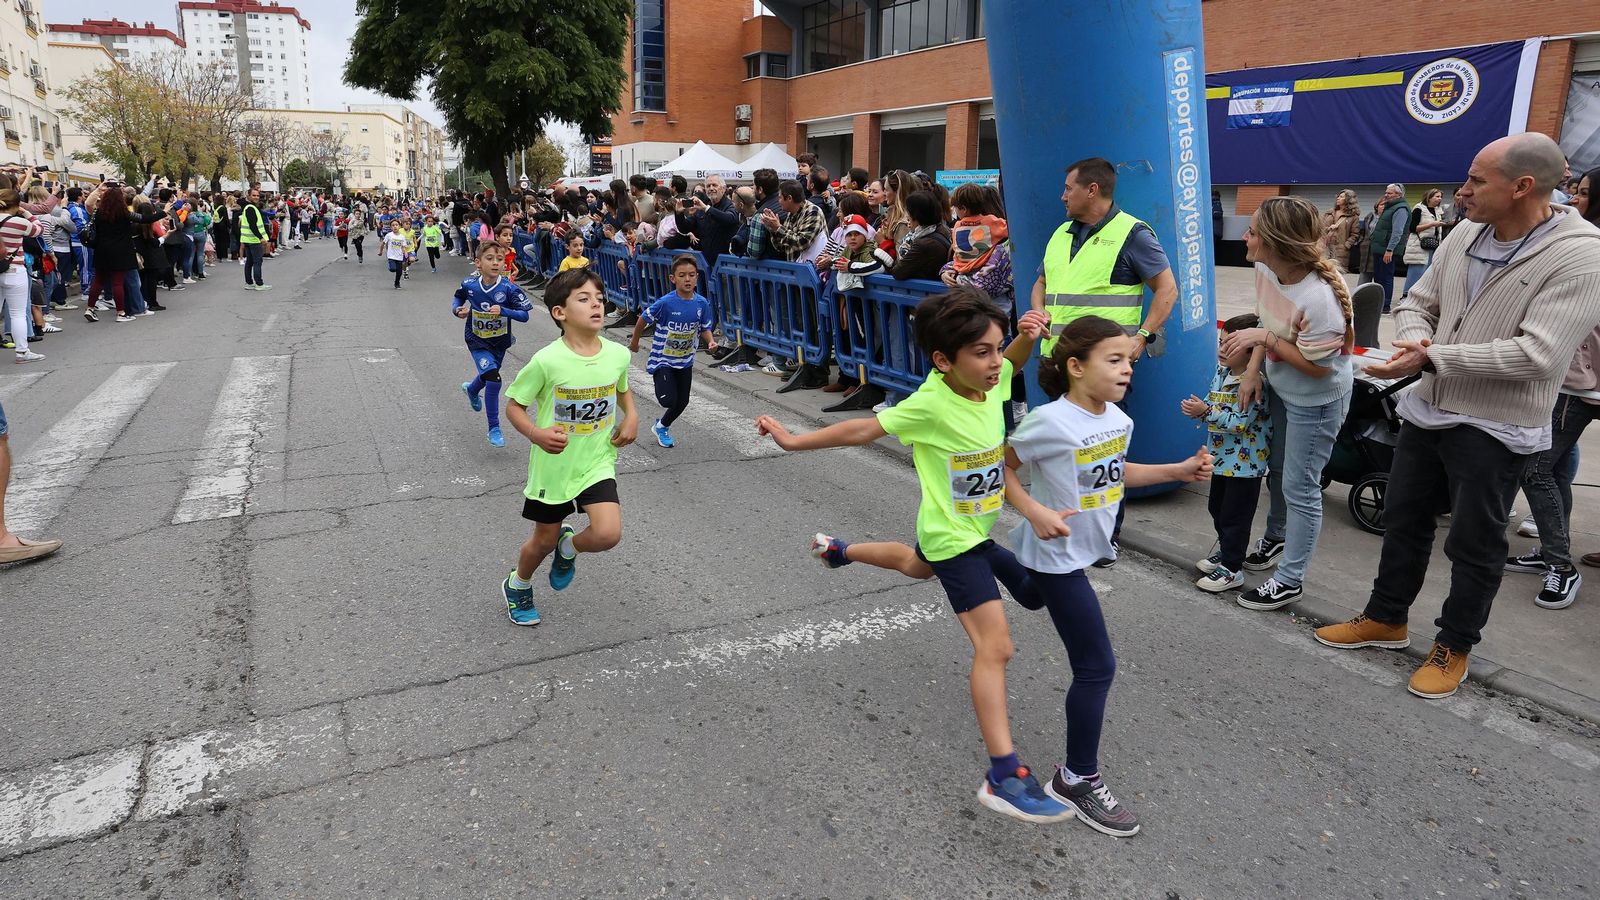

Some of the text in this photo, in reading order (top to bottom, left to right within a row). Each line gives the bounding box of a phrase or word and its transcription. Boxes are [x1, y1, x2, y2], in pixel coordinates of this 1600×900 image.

[1413, 63, 1445, 88] BOMBEROS
[1460, 67, 1474, 97] PROVINCIA
[1410, 96, 1434, 120] CONSORCIO
[1172, 56, 1204, 319] deportes@aytojerez.es
[477, 320, 503, 331] 063
[566, 393, 591, 401] BOMBEROS
[565, 400, 609, 421] 122
[966, 467, 1001, 497] 22
[1091, 459, 1121, 489] 26
